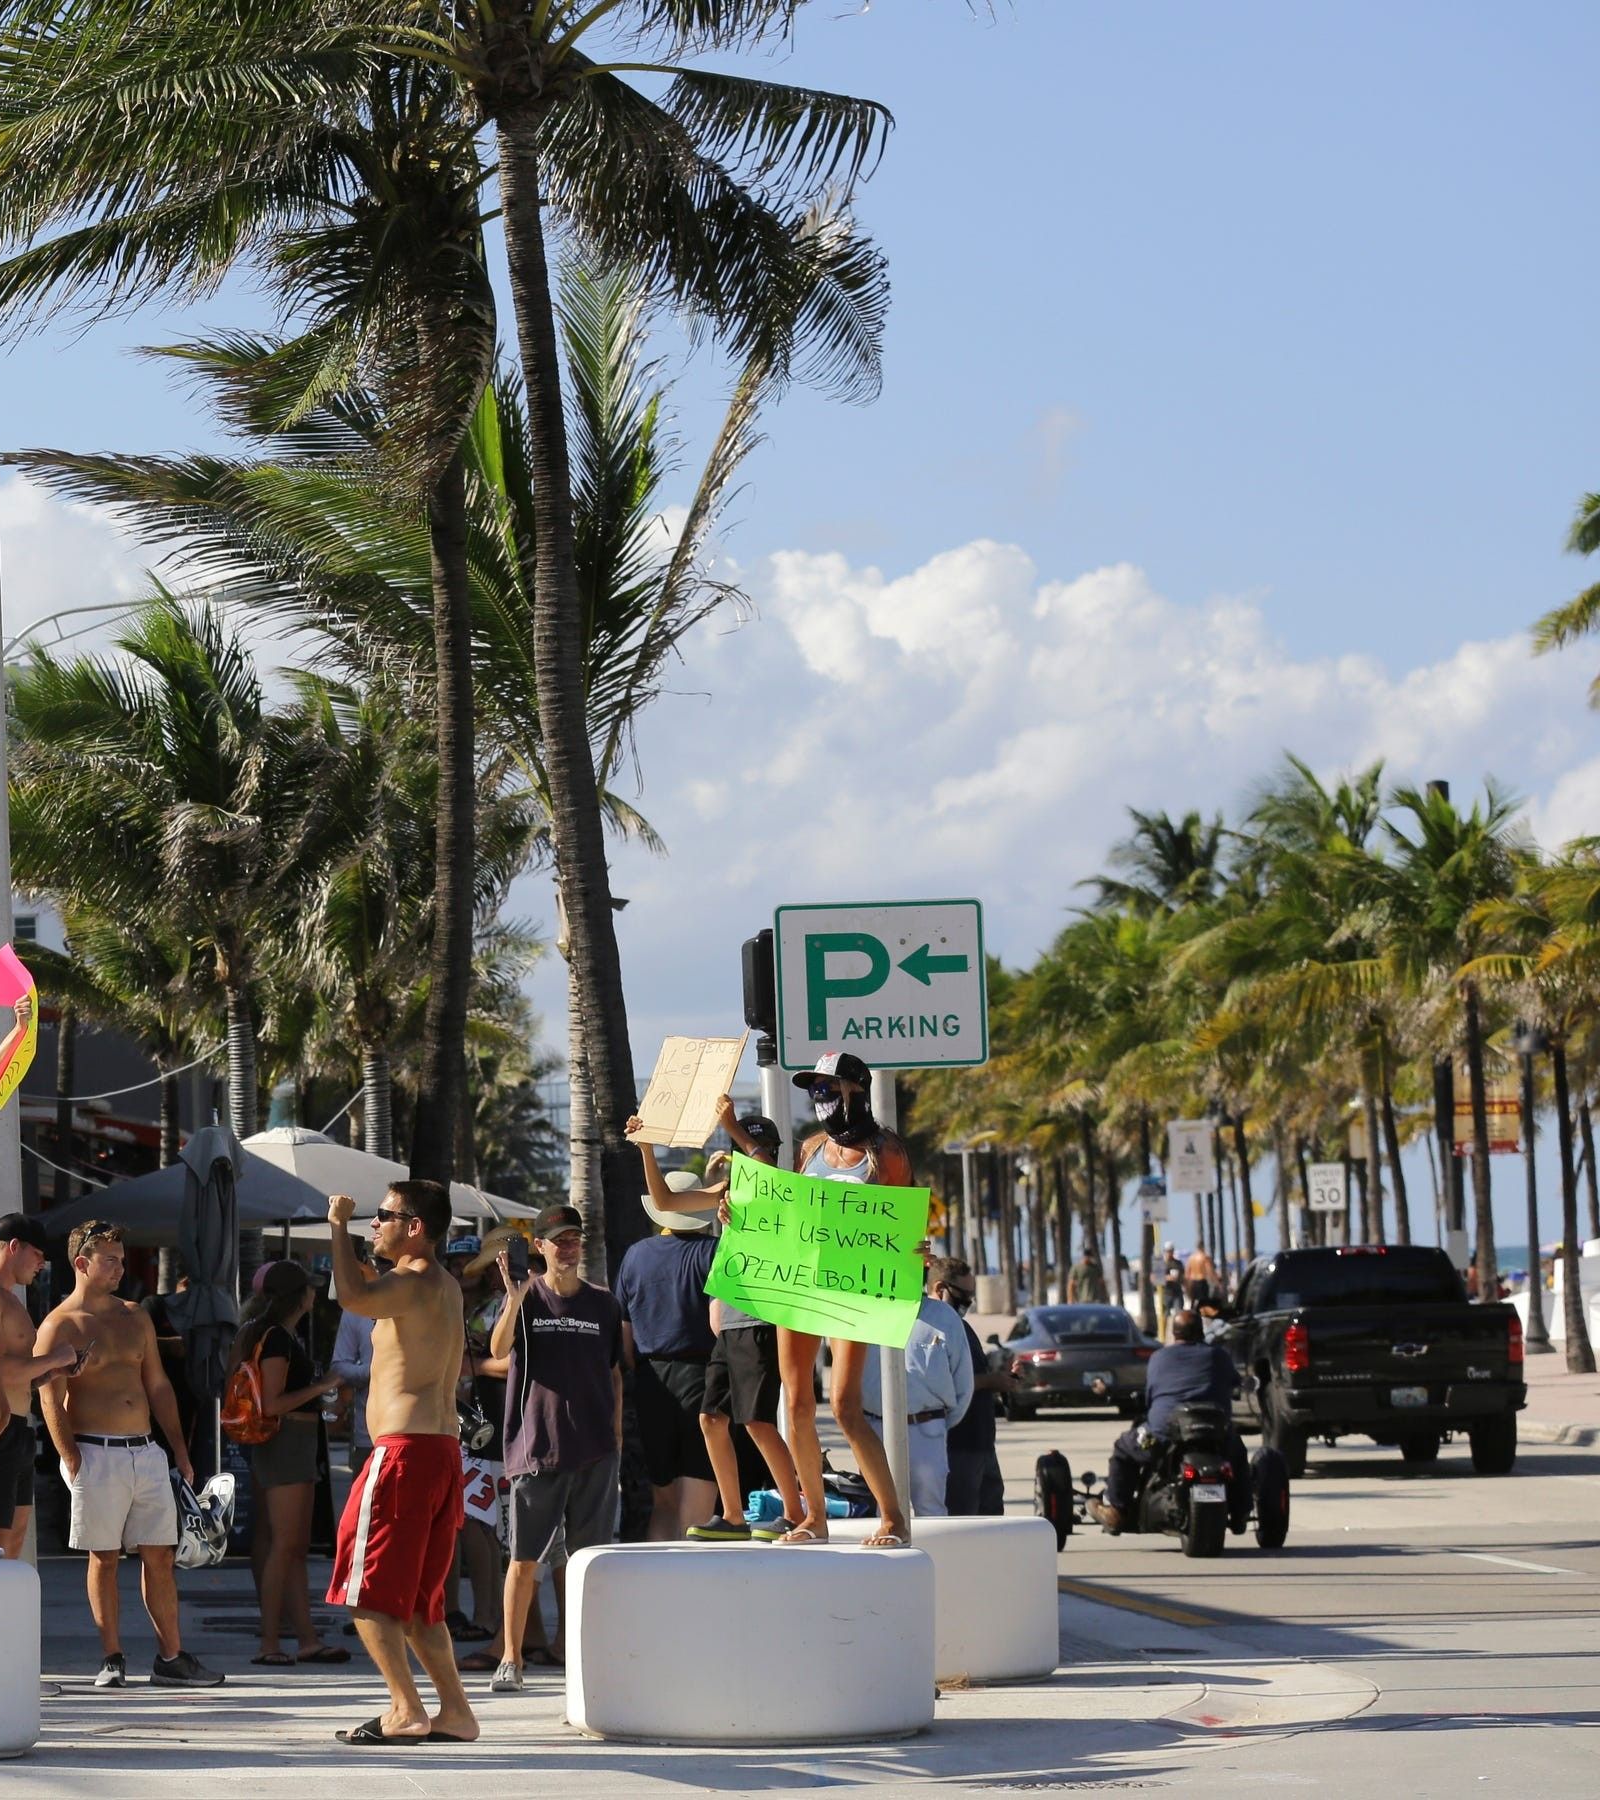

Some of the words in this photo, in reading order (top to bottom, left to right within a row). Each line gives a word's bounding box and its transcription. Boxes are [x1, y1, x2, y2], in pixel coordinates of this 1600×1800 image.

[735, 1164, 796, 1203] Make
[1313, 1187, 1342, 1204] 30
[740, 1206, 786, 1234] Let
